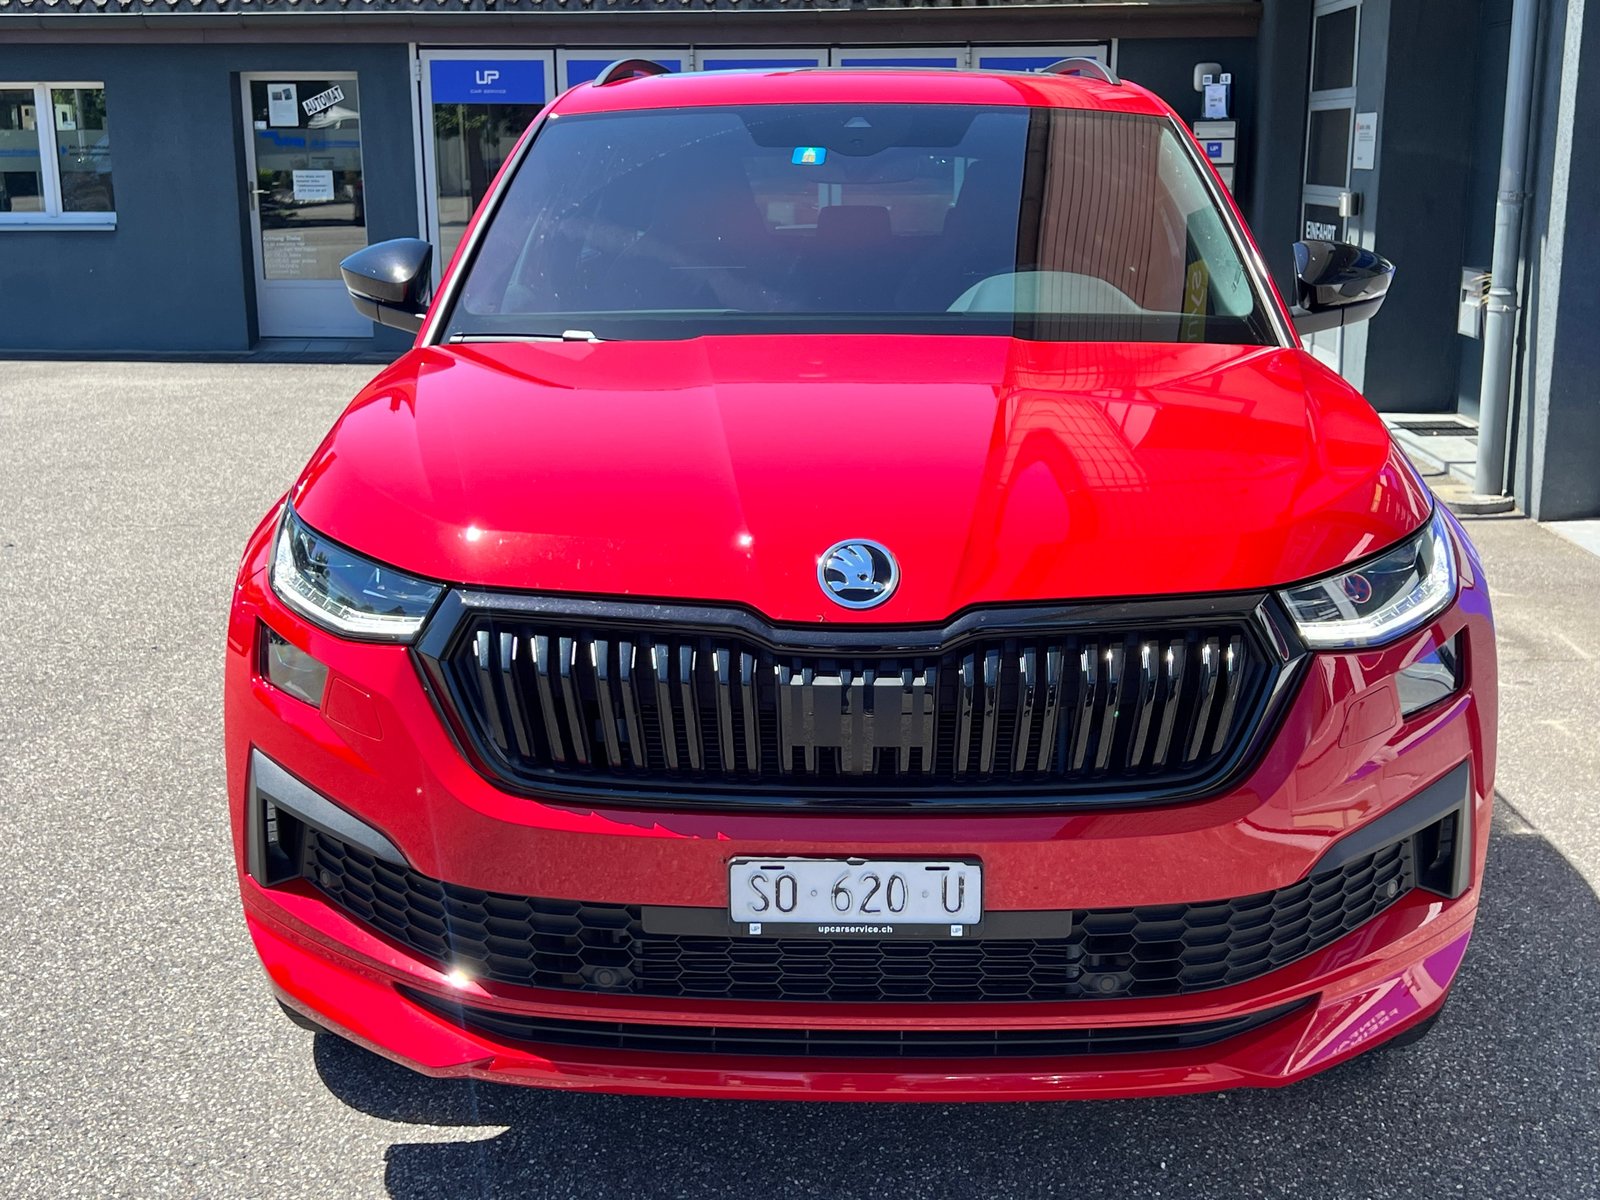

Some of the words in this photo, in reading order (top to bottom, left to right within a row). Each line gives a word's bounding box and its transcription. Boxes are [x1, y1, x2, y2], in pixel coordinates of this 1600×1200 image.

[476, 70, 500, 84] UP
[304, 86, 343, 115] AUTOMAT
[1305, 220, 1336, 240] EINFAHRT
[748, 872, 798, 913] SO
[831, 871, 908, 914] 620
[942, 873, 965, 914] U
[818, 925, 893, 934] upcarservice.ch
